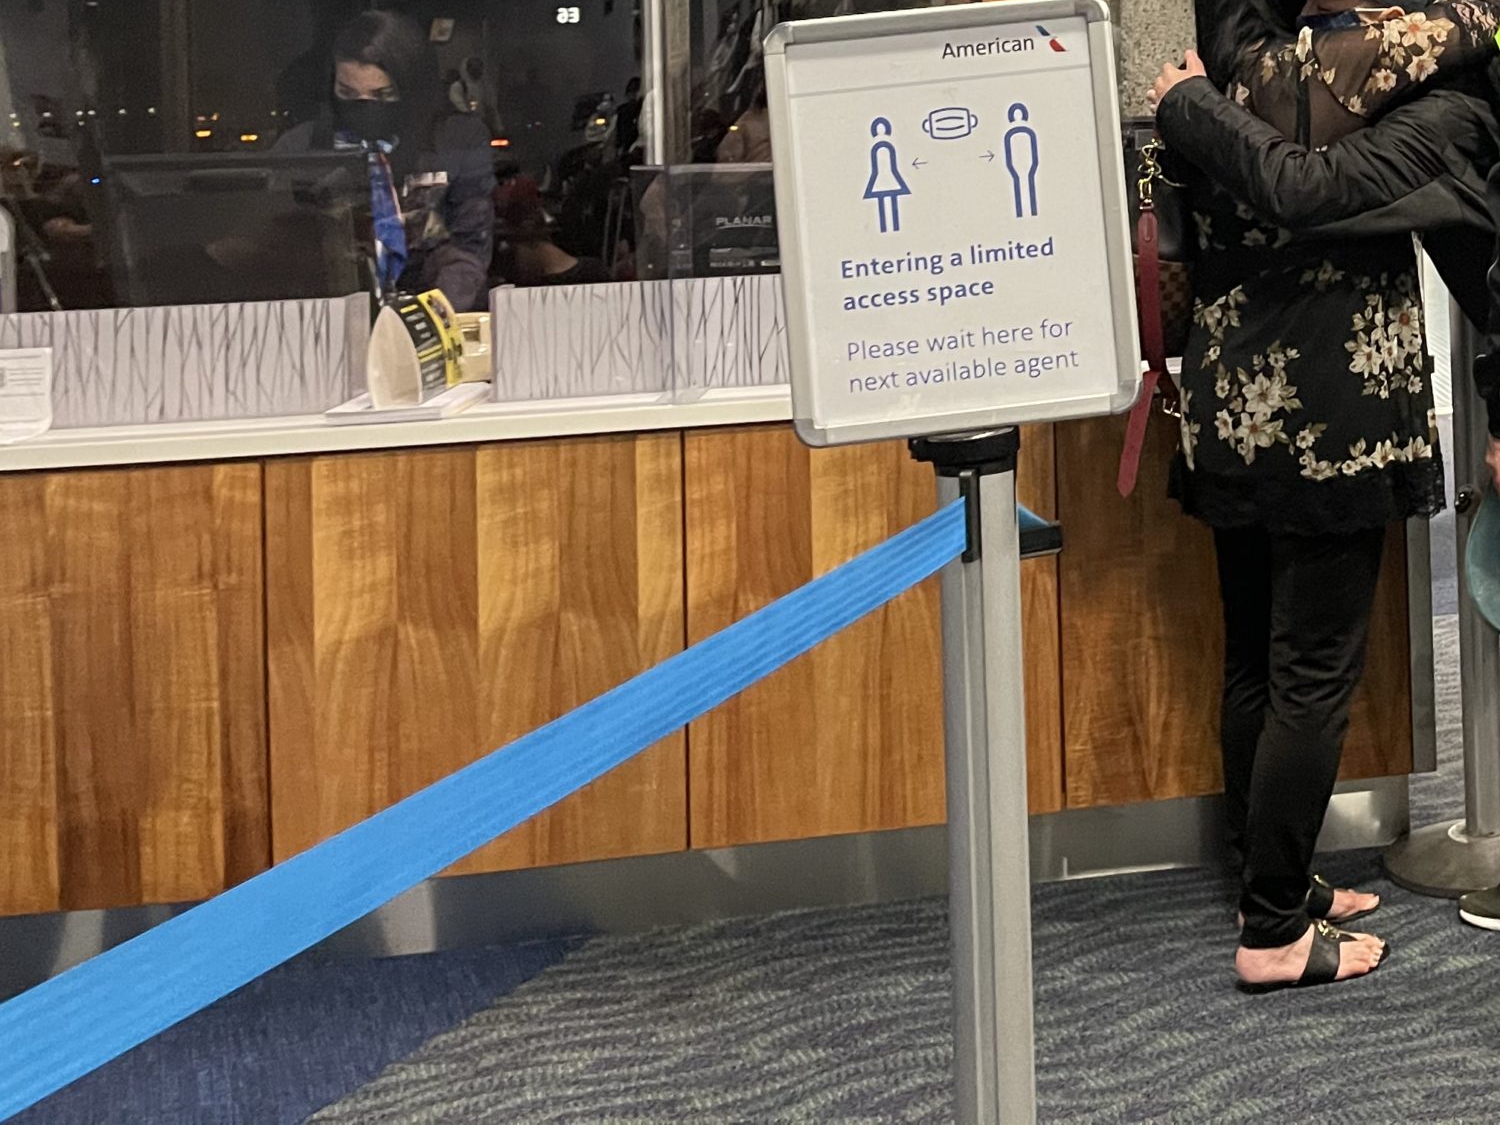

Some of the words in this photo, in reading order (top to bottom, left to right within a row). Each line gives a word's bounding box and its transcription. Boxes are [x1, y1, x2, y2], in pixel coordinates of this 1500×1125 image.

[942, 37, 1034, 59] American
[716, 216, 773, 226] PLANAR
[841, 251, 944, 279] Entering
[950, 252, 963, 267] a
[971, 236, 1054, 265] limited
[843, 286, 920, 310] access
[927, 280, 994, 306] space
[848, 339, 920, 361] Please
[926, 328, 975, 353] wait
[982, 325, 1034, 347] here
[1040, 318, 1073, 340] for
[850, 371, 900, 393] next
[905, 357, 1007, 387] available
[1014, 350, 1079, 378] agent
